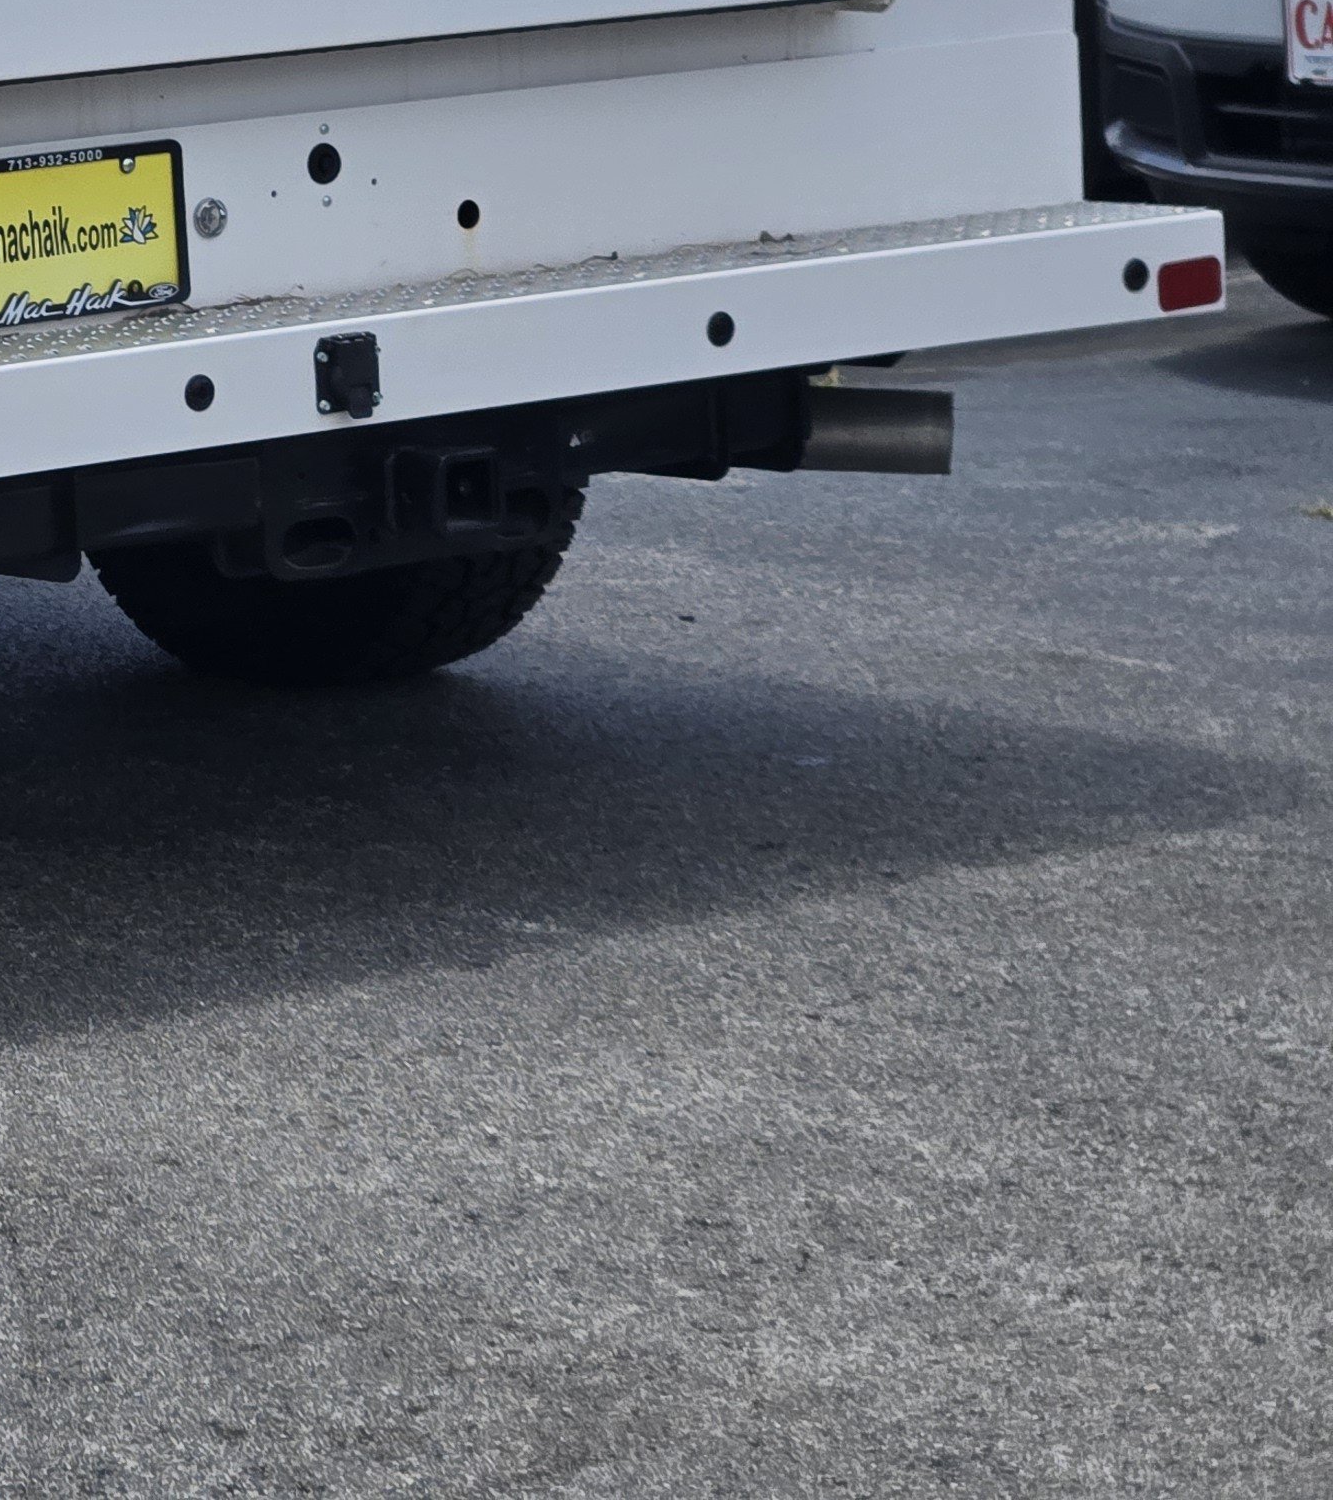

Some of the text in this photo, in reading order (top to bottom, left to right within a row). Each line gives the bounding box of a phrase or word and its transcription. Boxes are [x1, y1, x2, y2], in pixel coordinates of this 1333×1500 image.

[6, 149, 103, 171] 713-932-5000
[2, 281, 129, 325] Mac Haik
